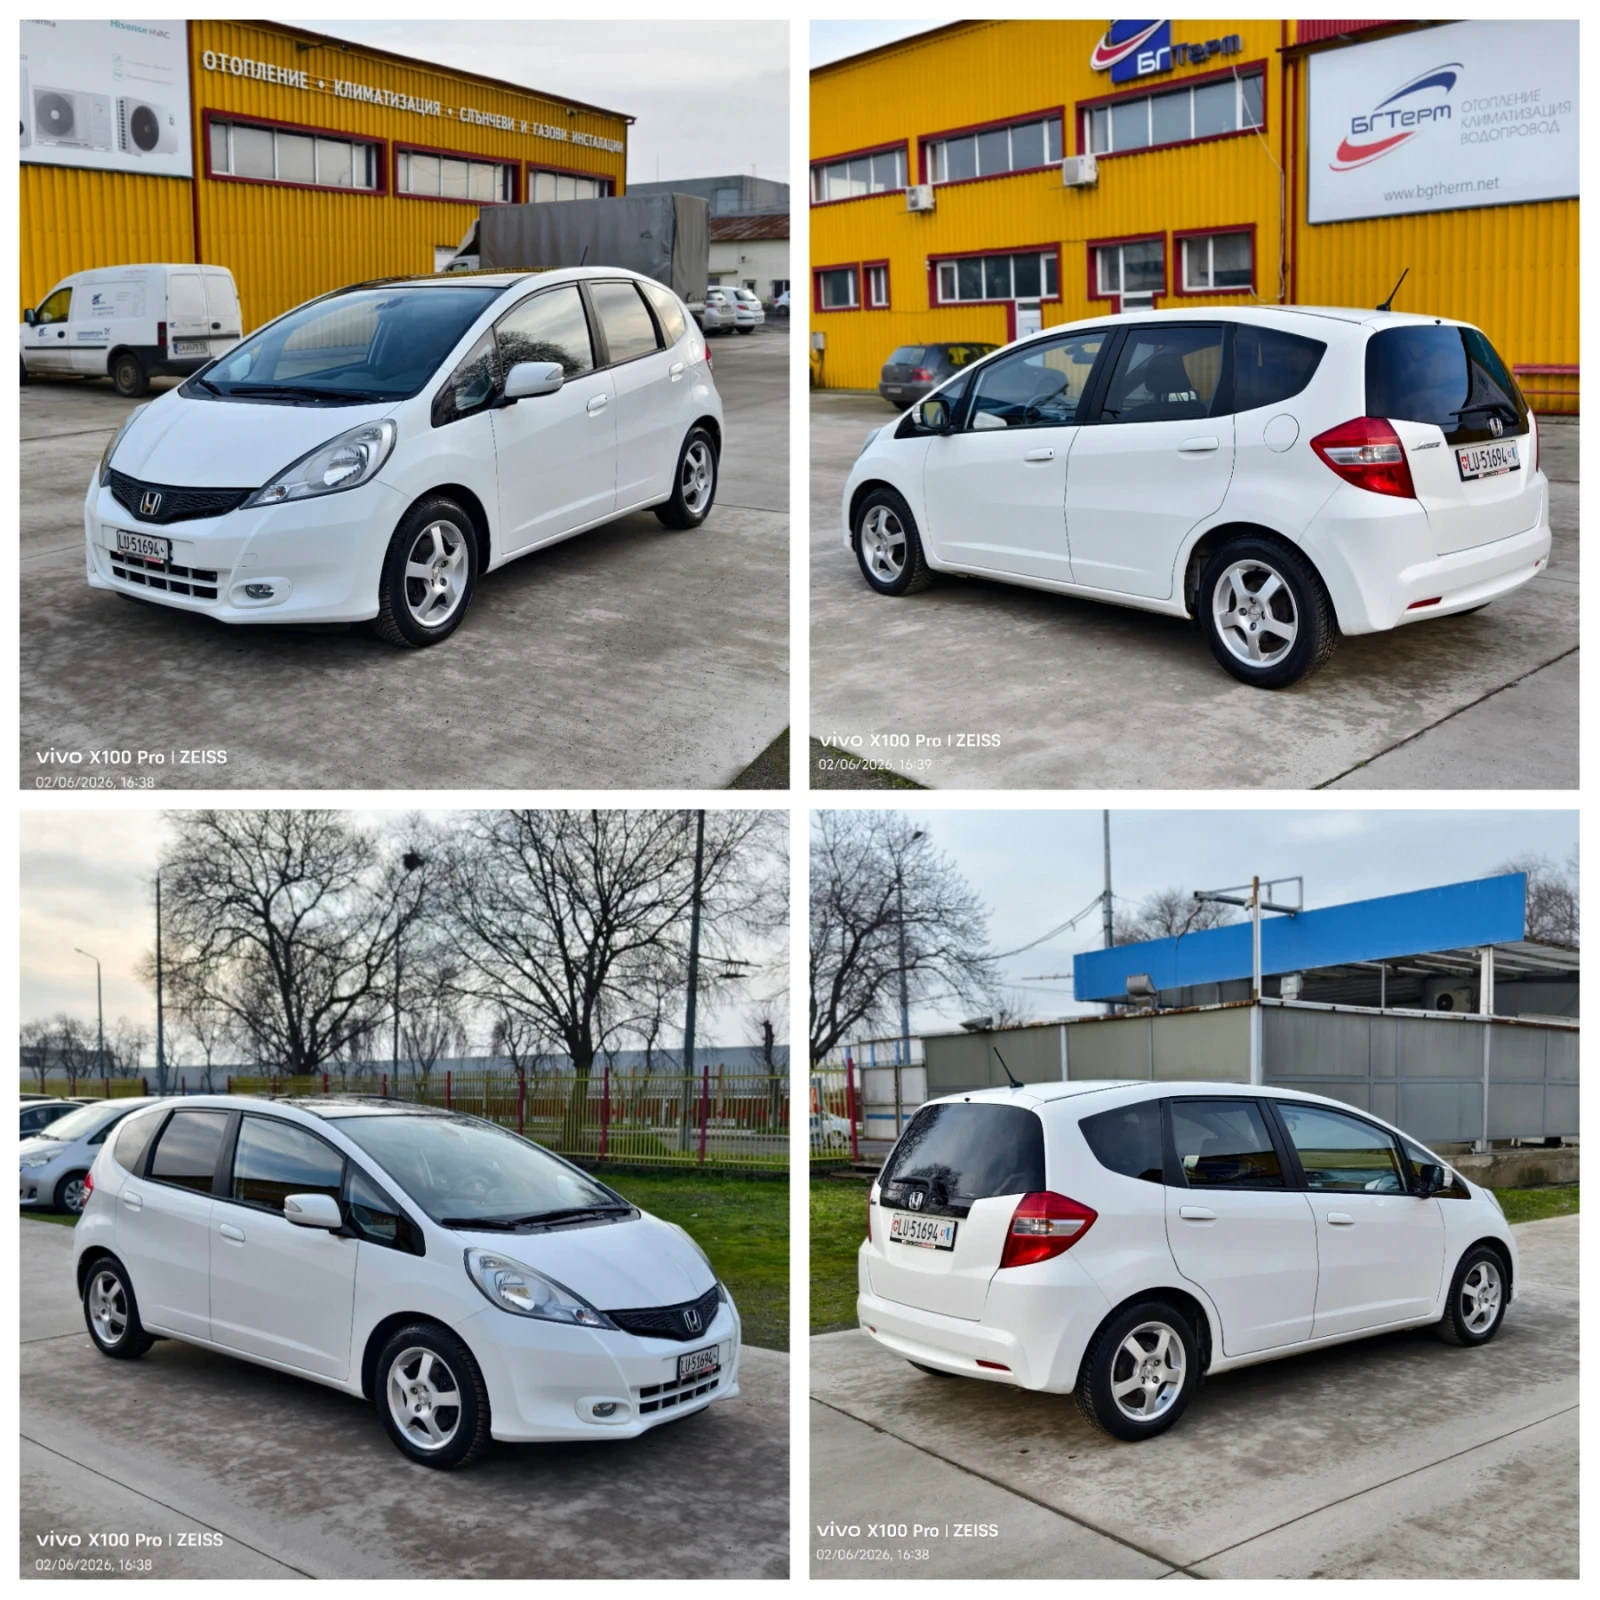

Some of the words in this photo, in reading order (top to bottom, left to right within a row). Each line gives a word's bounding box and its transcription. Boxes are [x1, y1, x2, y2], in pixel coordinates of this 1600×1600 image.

[149, 28, 171, 39] HVAC
[203, 50, 309, 89] ОТОПЛЕНИЕ
[334, 79, 441, 116] КЛИМАТИЗАЦИЯ
[459, 106, 514, 131] СЛЪНЧЕВИ
[520, 119, 527, 133] И
[533, 122, 567, 141] ГАЗОВИ
[572, 132, 624, 154] ИНСТАЛАЦИИ
[1461, 89, 1542, 113] ОТОПЛЕНИЕ
[1460, 101, 1572, 129] КЛИМАТИЗАЦИЯ
[1460, 119, 1561, 145] ВОДОПРОВОД
[1383, 177, 1500, 201] www.bgtherm.net
